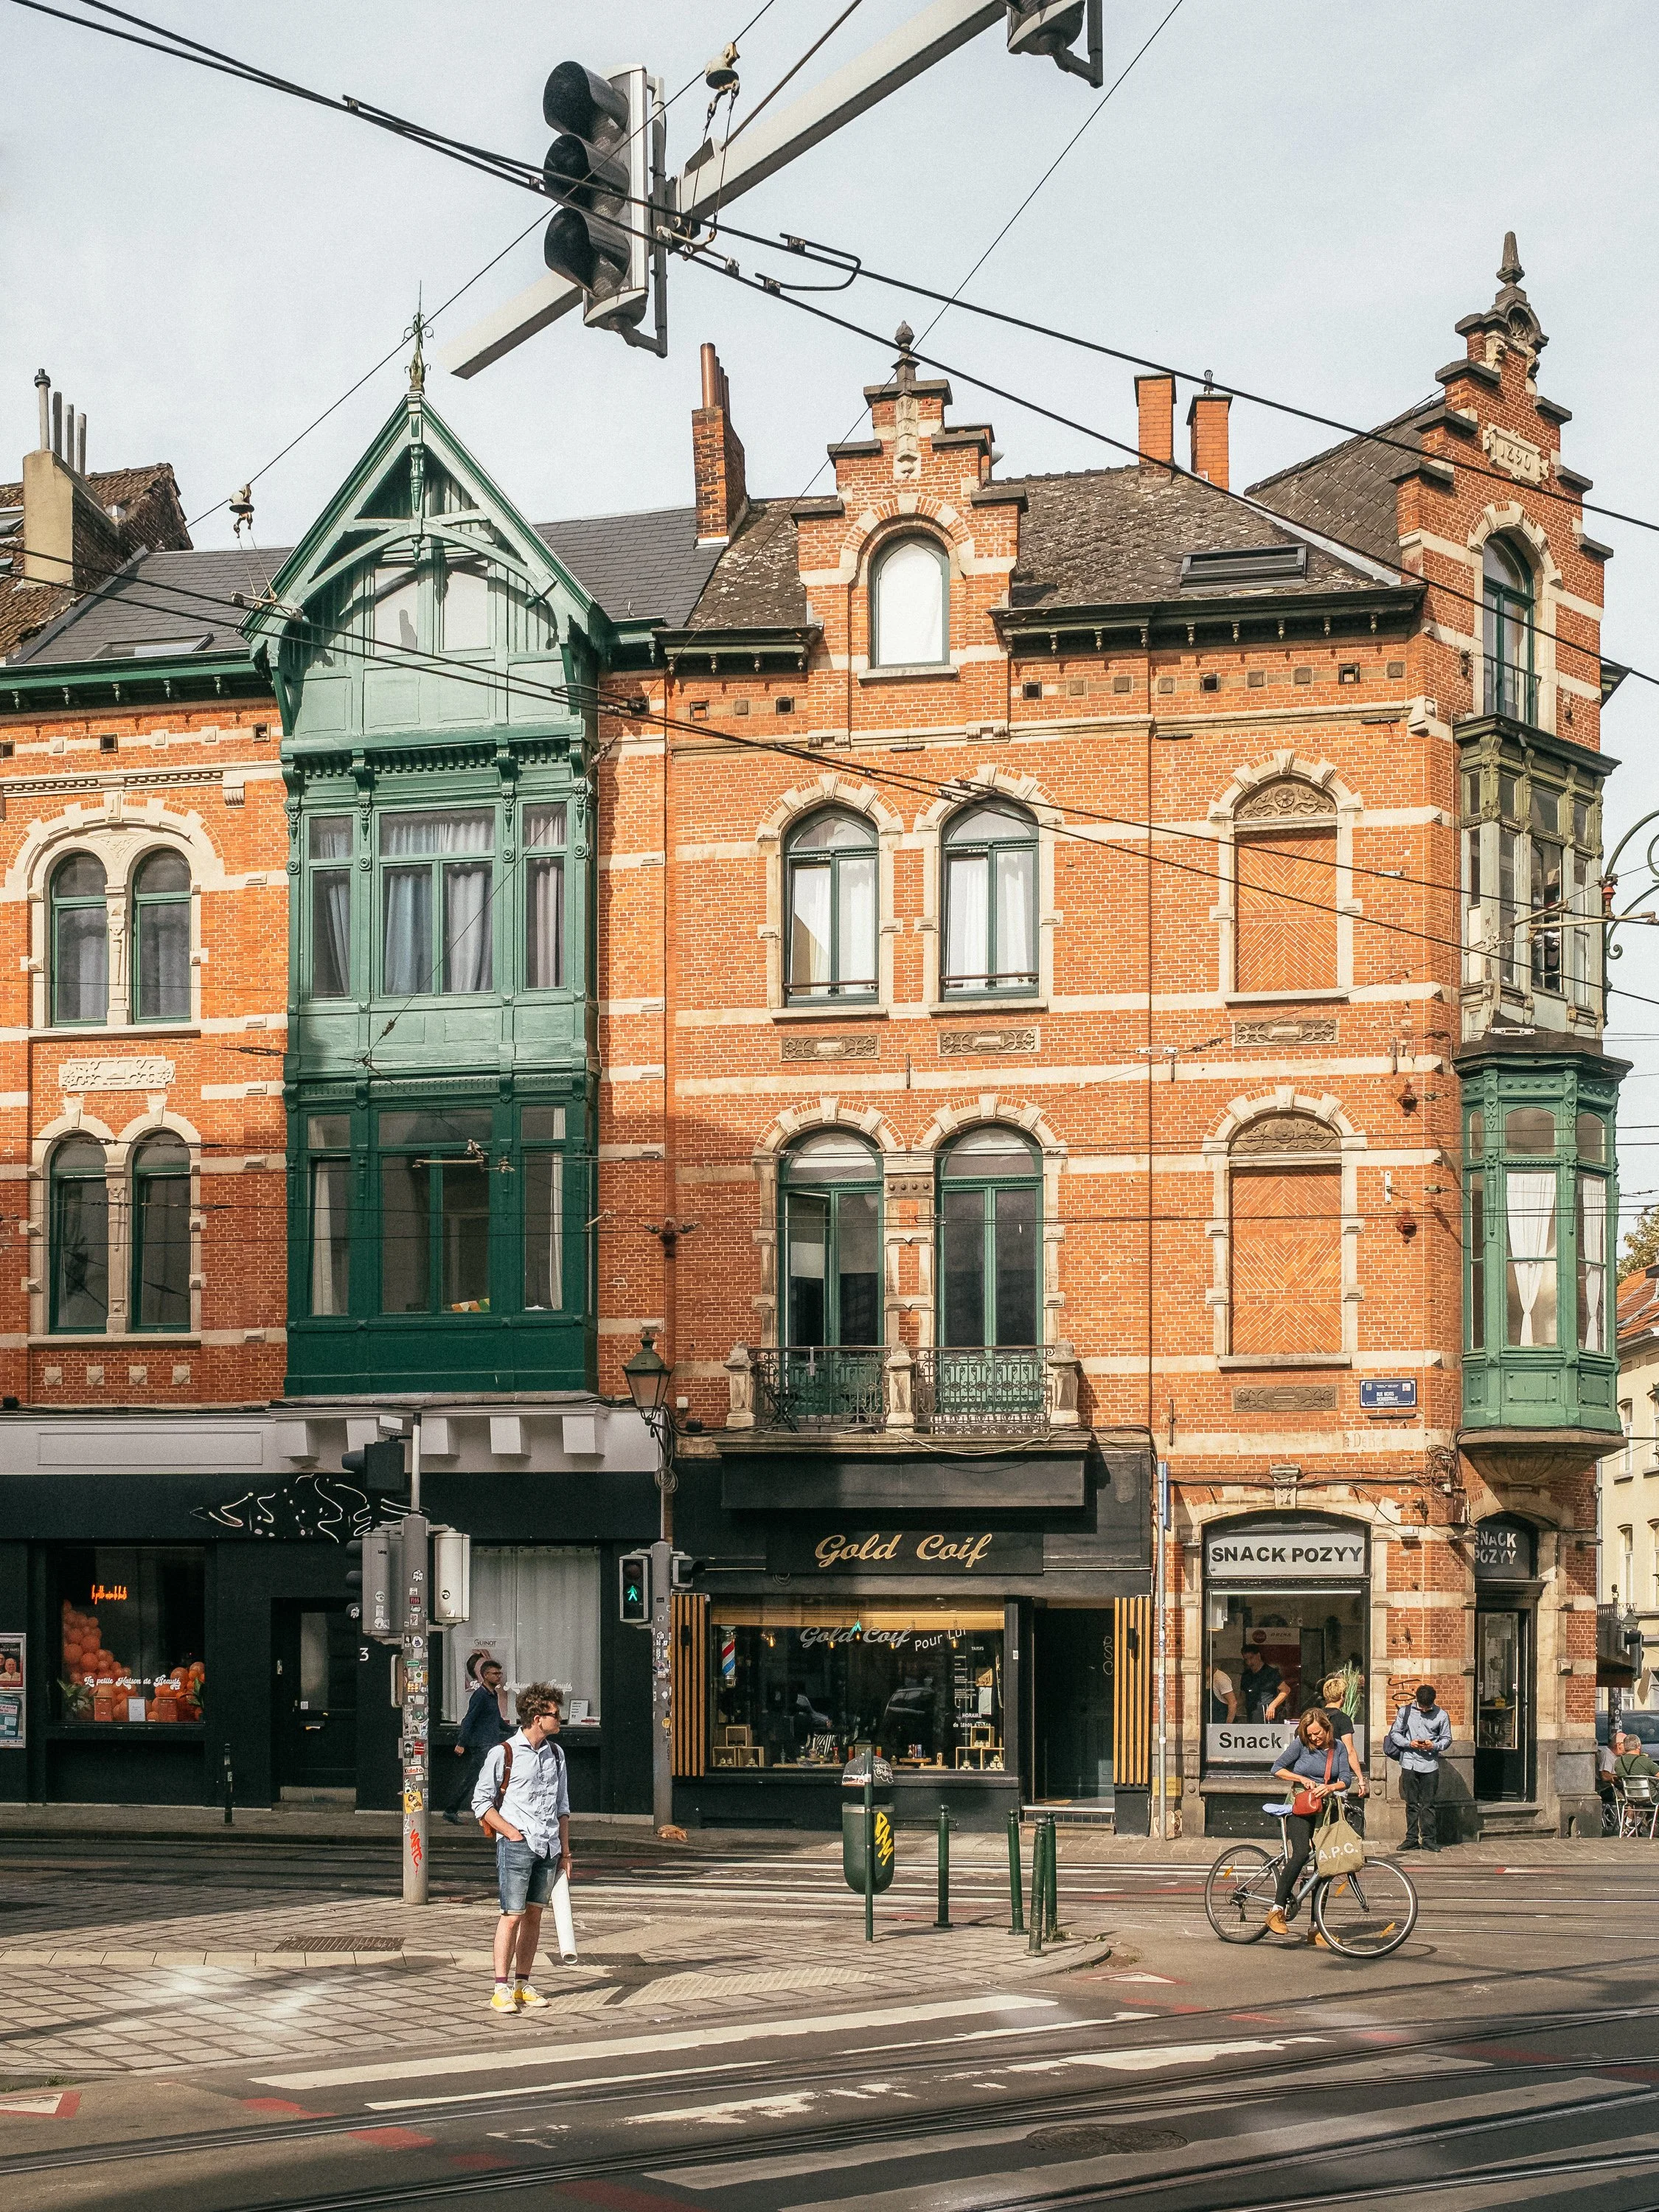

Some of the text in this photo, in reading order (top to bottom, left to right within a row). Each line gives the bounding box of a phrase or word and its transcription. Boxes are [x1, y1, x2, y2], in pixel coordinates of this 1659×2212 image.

[1474, 1531, 1517, 1548] SNACK
[815, 1533, 992, 1568] Gold Coif
[1211, 1546, 1363, 1563] SNACK POZYY
[1475, 1548, 1517, 1565] POZYY
[800, 1626, 912, 1648] Gold Coif
[914, 1634, 943, 1652] Pour
[359, 1647, 369, 1661] 3
[83, 1675, 94, 1688] La
[97, 1677, 114, 1686] petite
[116, 1677, 142, 1690] Maison
[153, 1674, 181, 1690] Beauté
[1219, 1731, 1282, 1749] Snack
[1318, 1842, 1358, 1862] A.P.C.
